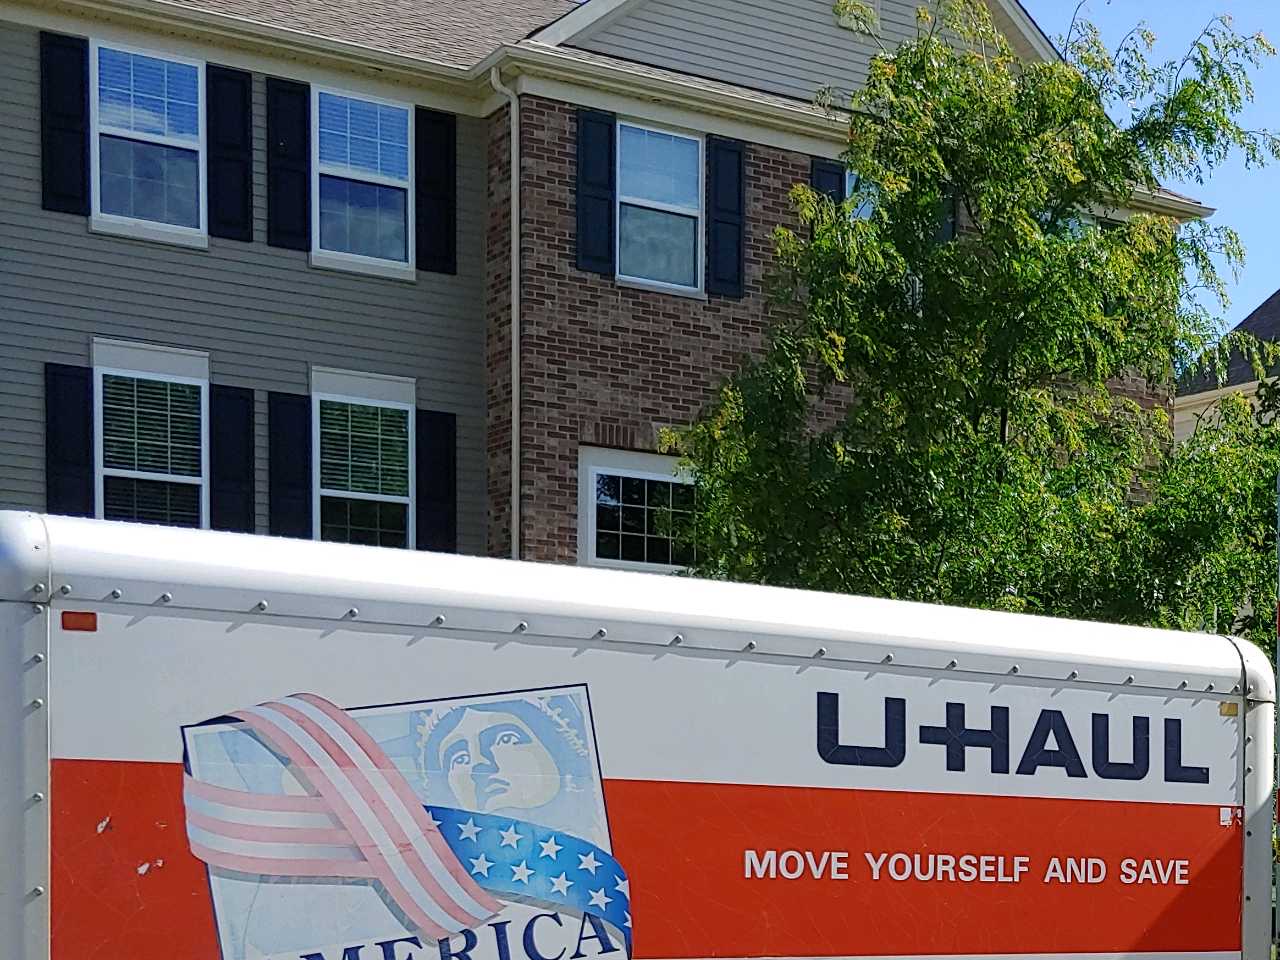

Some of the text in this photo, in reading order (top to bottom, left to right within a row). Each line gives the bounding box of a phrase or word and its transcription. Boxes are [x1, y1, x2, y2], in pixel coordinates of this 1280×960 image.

[816, 691, 1210, 784] U-HAUL
[744, 850, 1189, 885] MOVE YOURSELF AND SAVE
